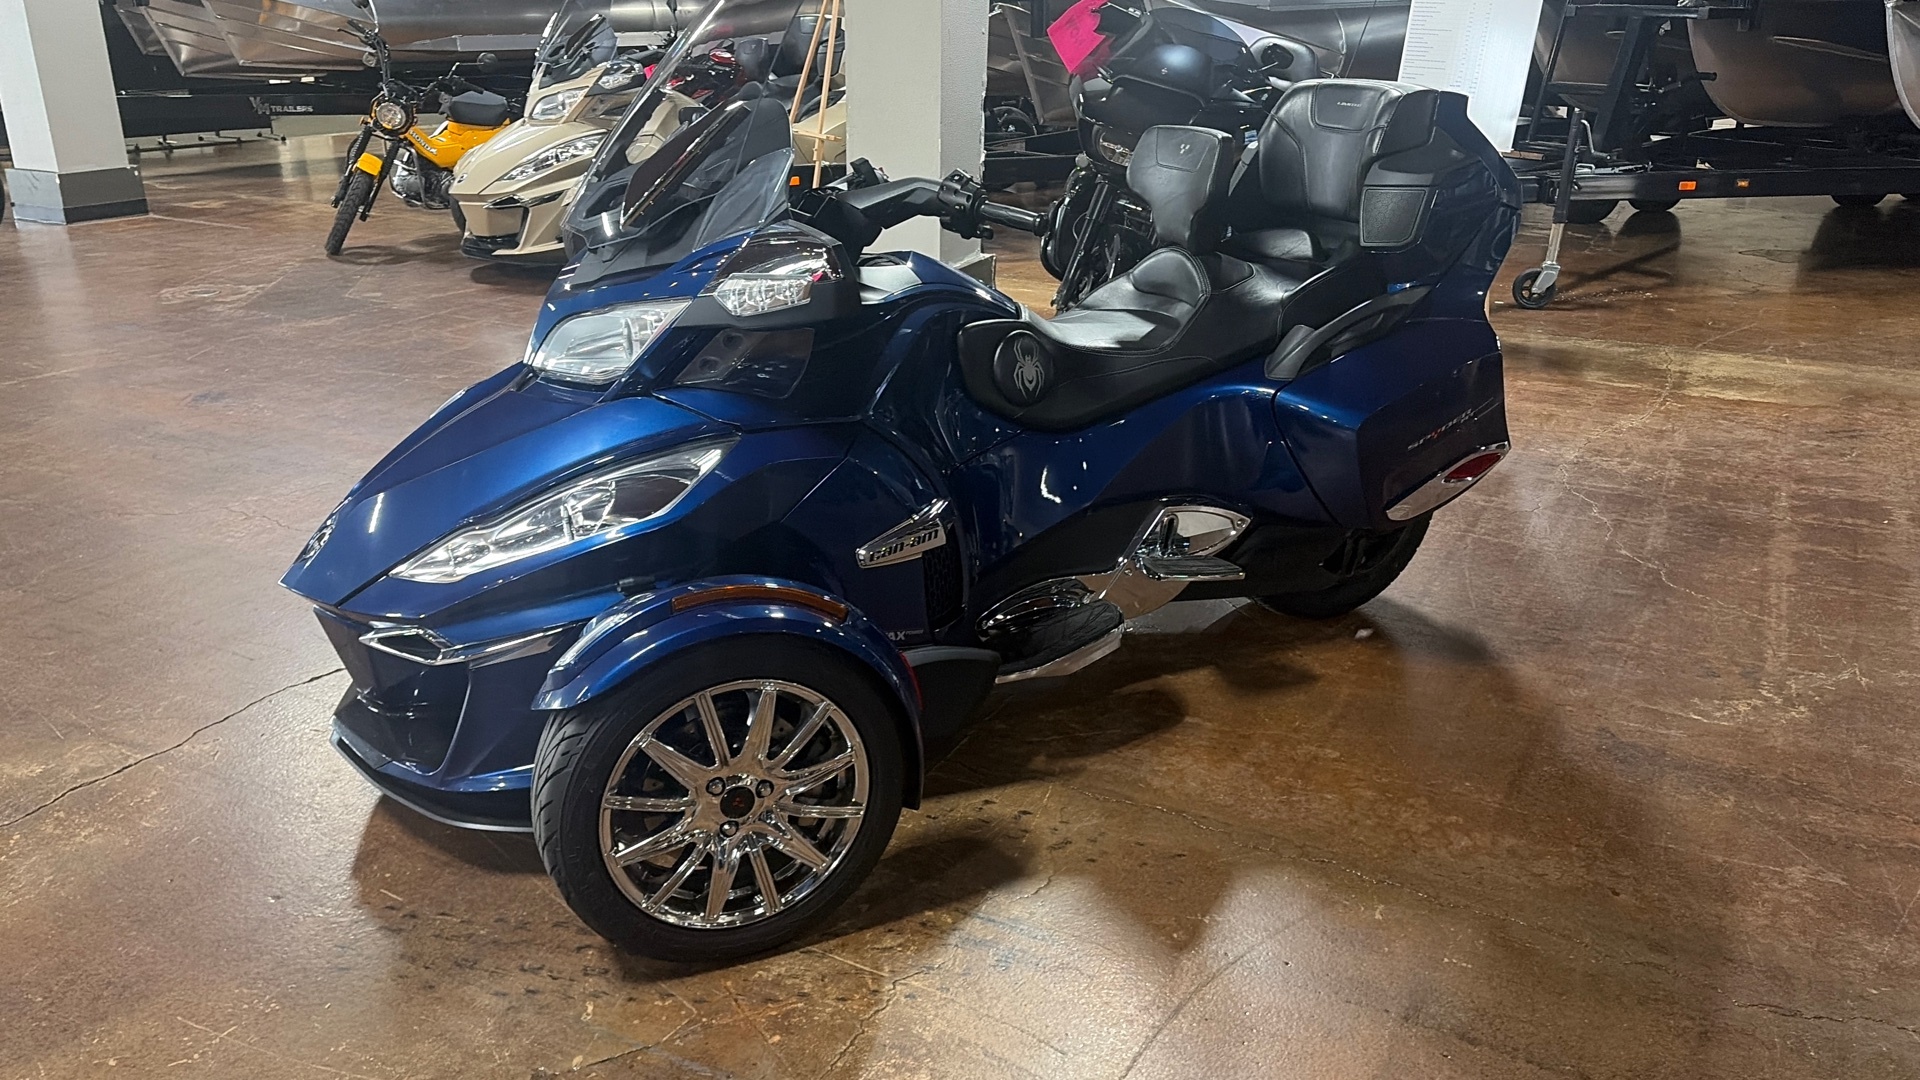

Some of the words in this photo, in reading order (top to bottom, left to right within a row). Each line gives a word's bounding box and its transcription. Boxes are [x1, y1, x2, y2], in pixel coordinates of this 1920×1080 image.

[270, 104, 314, 113] TRAILERS
[410, 130, 438, 155] HONDA
[869, 528, 939, 563] can-am
